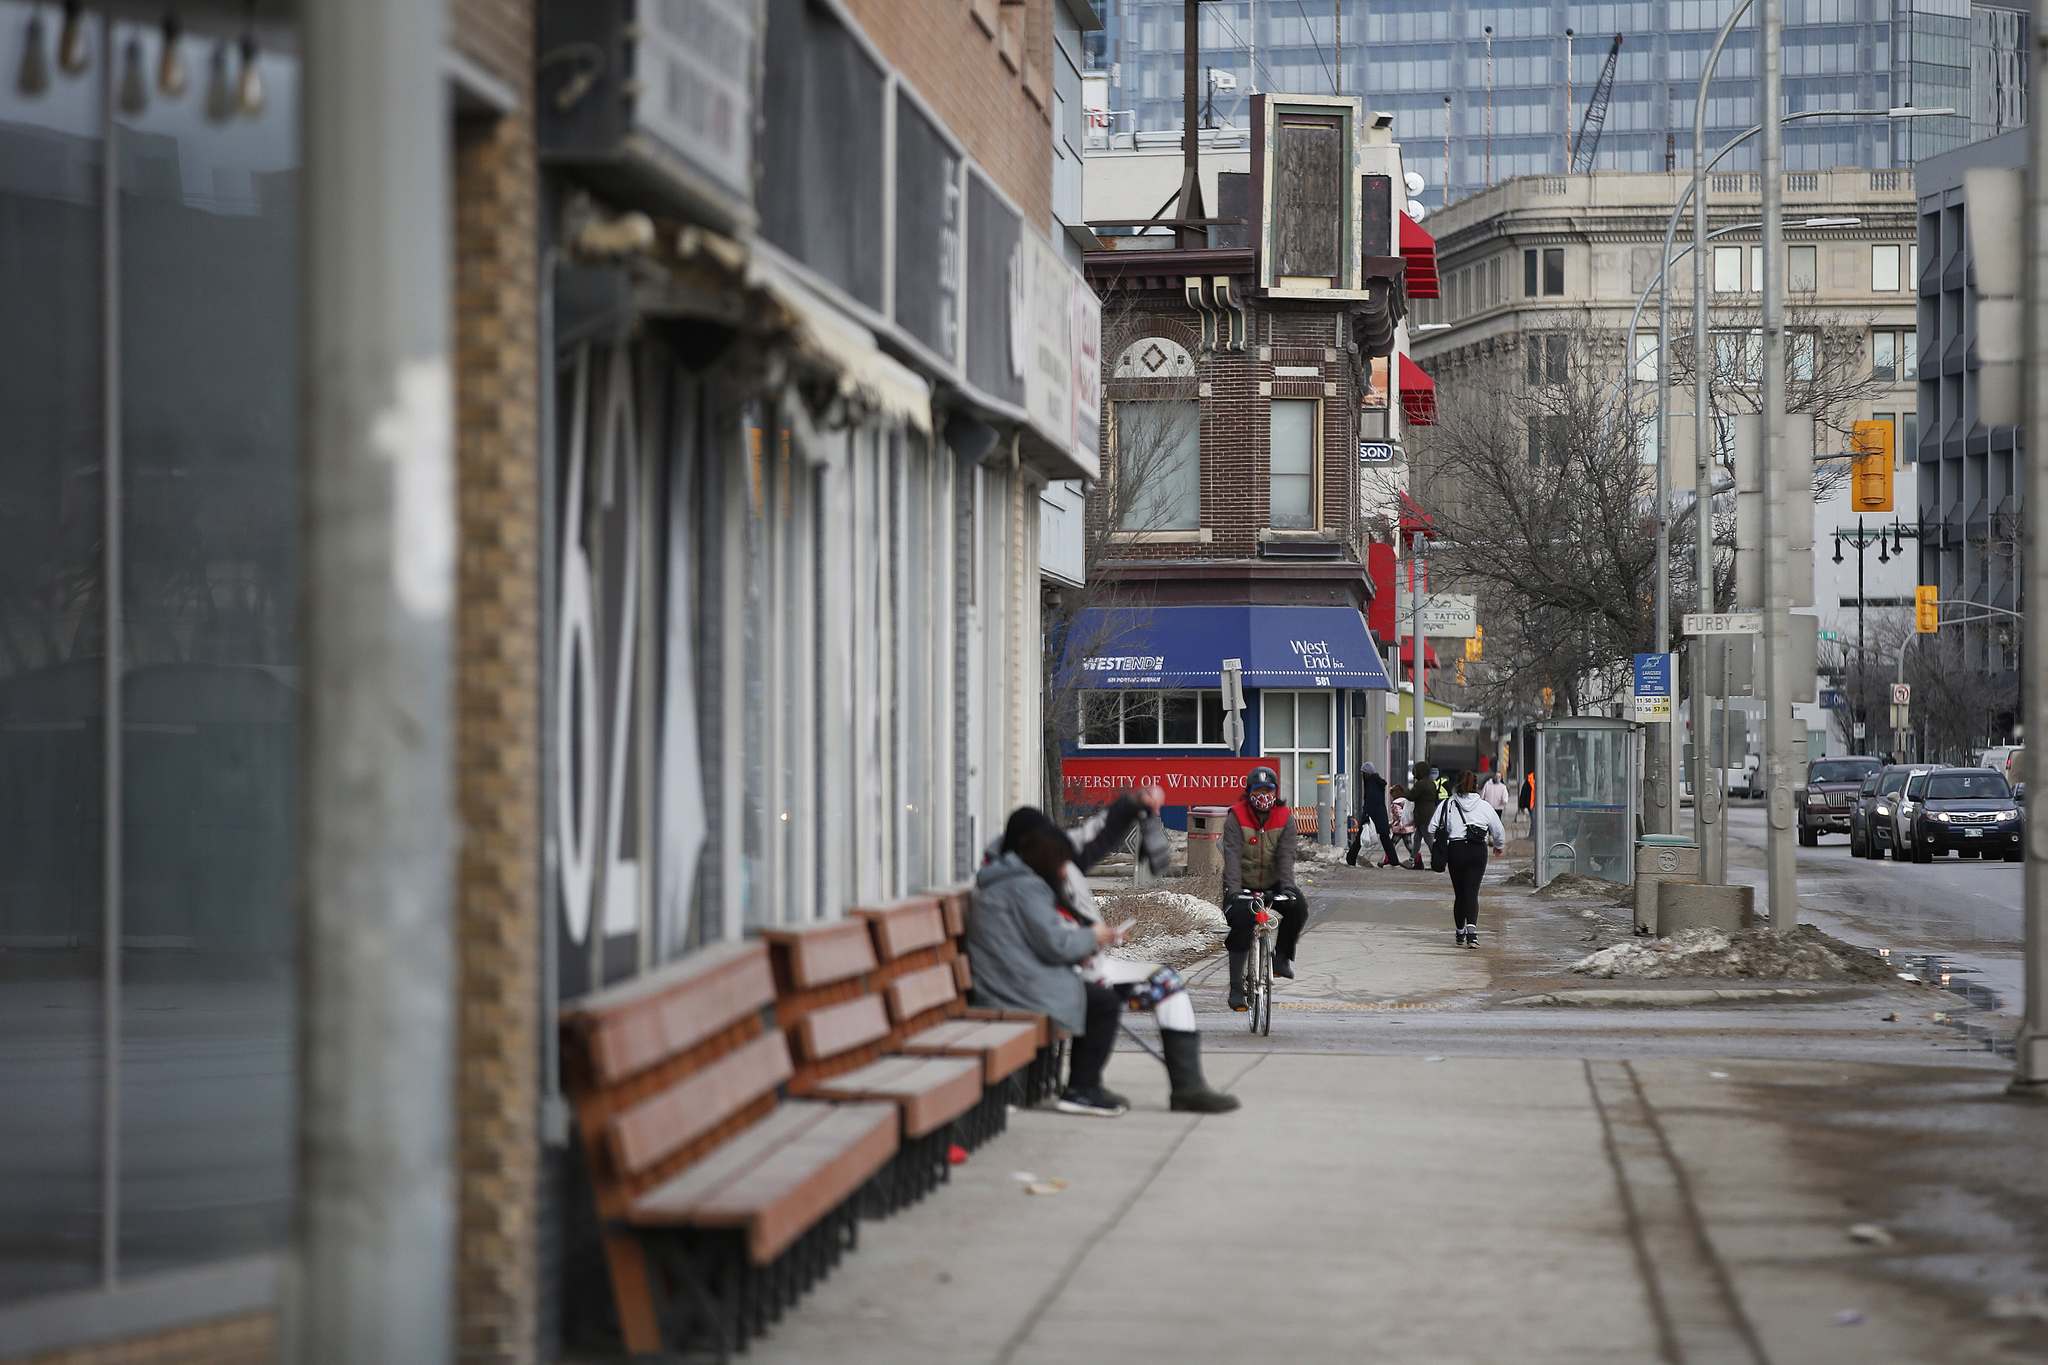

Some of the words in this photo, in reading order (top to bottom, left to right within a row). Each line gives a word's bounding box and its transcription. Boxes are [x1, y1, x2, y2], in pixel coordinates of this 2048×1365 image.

[1434, 612, 1471, 621] TATTOO
[1687, 616, 1732, 632] FURBY
[1290, 640, 1329, 654] West
[1304, 655, 1331, 668] End
[1315, 676, 1331, 686] 581
[1141, 775, 1161, 788] OF
